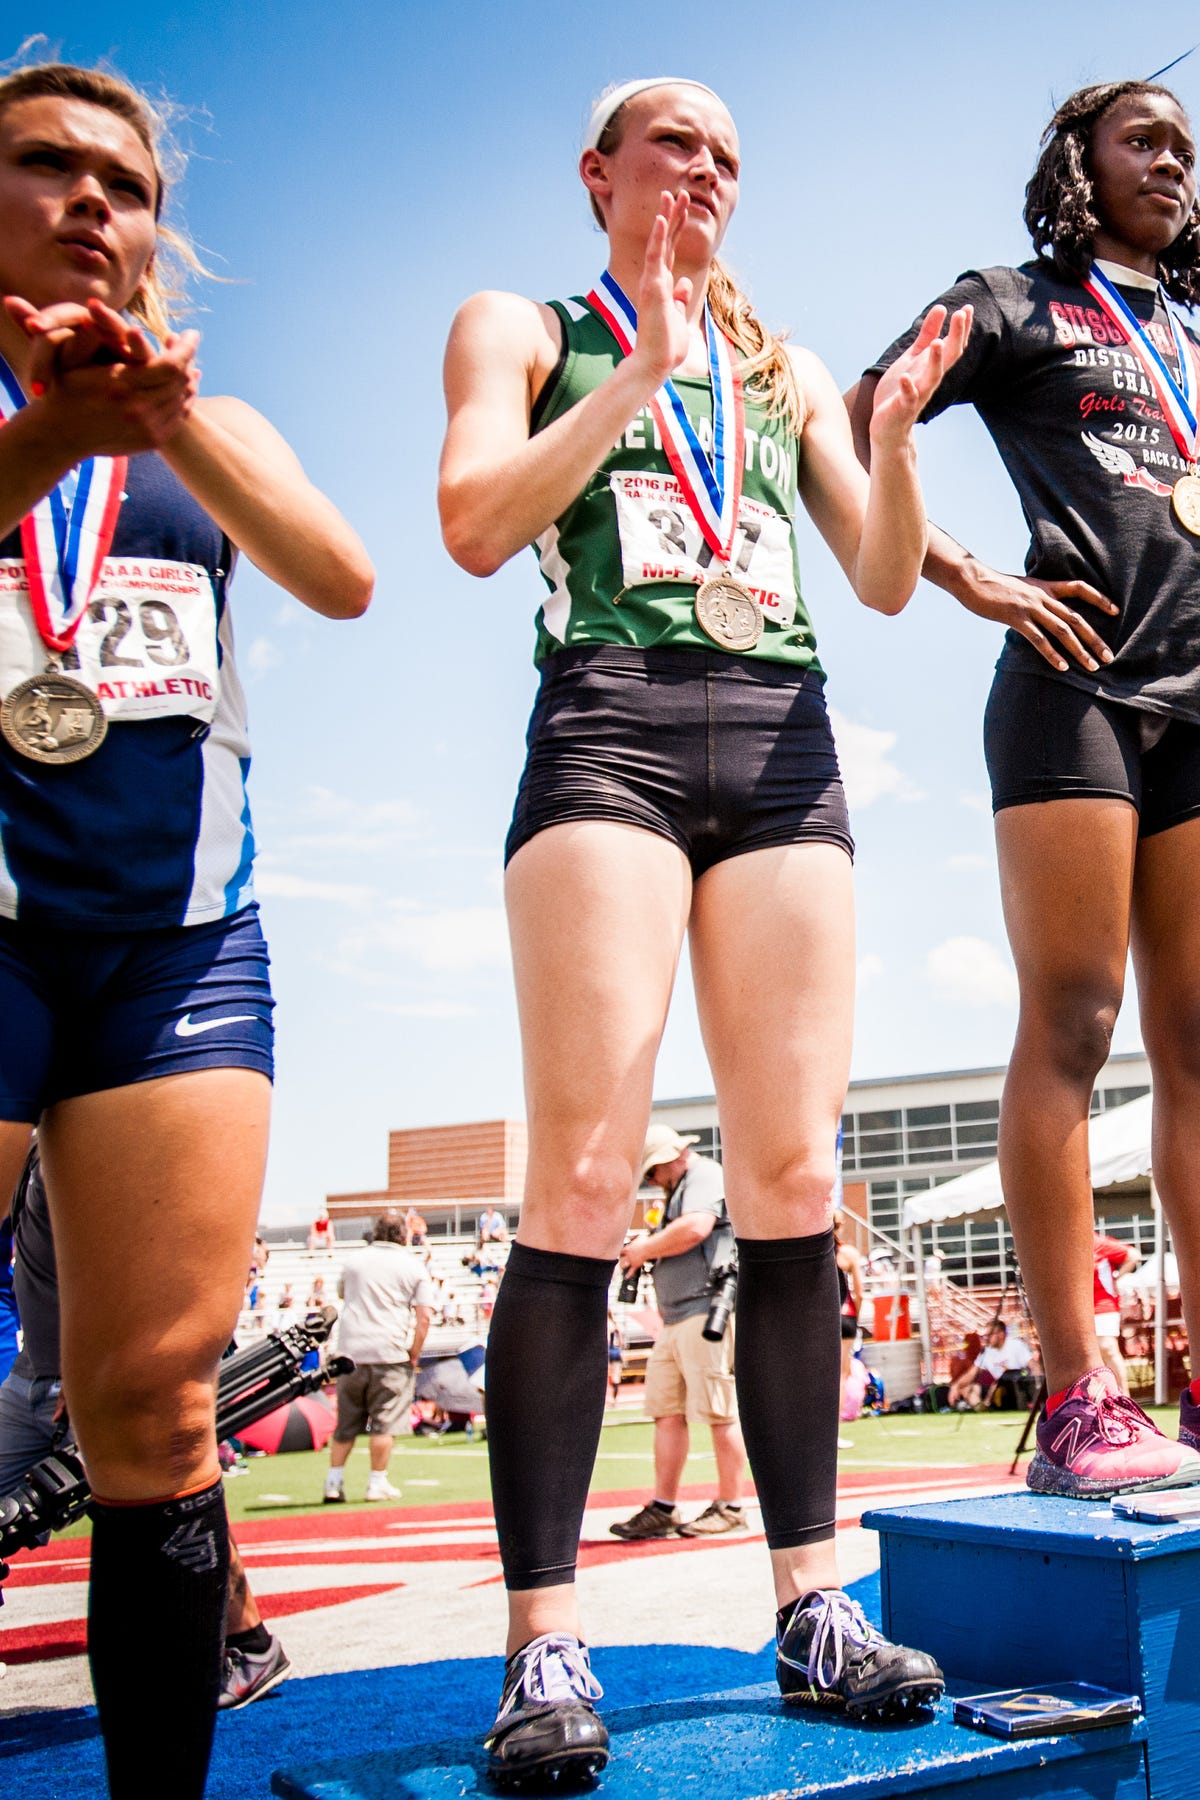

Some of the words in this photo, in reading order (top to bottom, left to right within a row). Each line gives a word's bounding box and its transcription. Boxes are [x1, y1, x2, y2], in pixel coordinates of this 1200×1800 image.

[1079, 391, 1126, 419] Girls
[1111, 422, 1160, 445] 2015
[1142, 448, 1170, 467] BACK
[1171, 455, 1178, 470] 2
[624, 477, 659, 490] 2016
[669, 496, 688, 506] FIE
[149, 565, 195, 583] GIRLS
[642, 562, 685, 579] M-F
[97, 678, 213, 702] ATHLETIC
